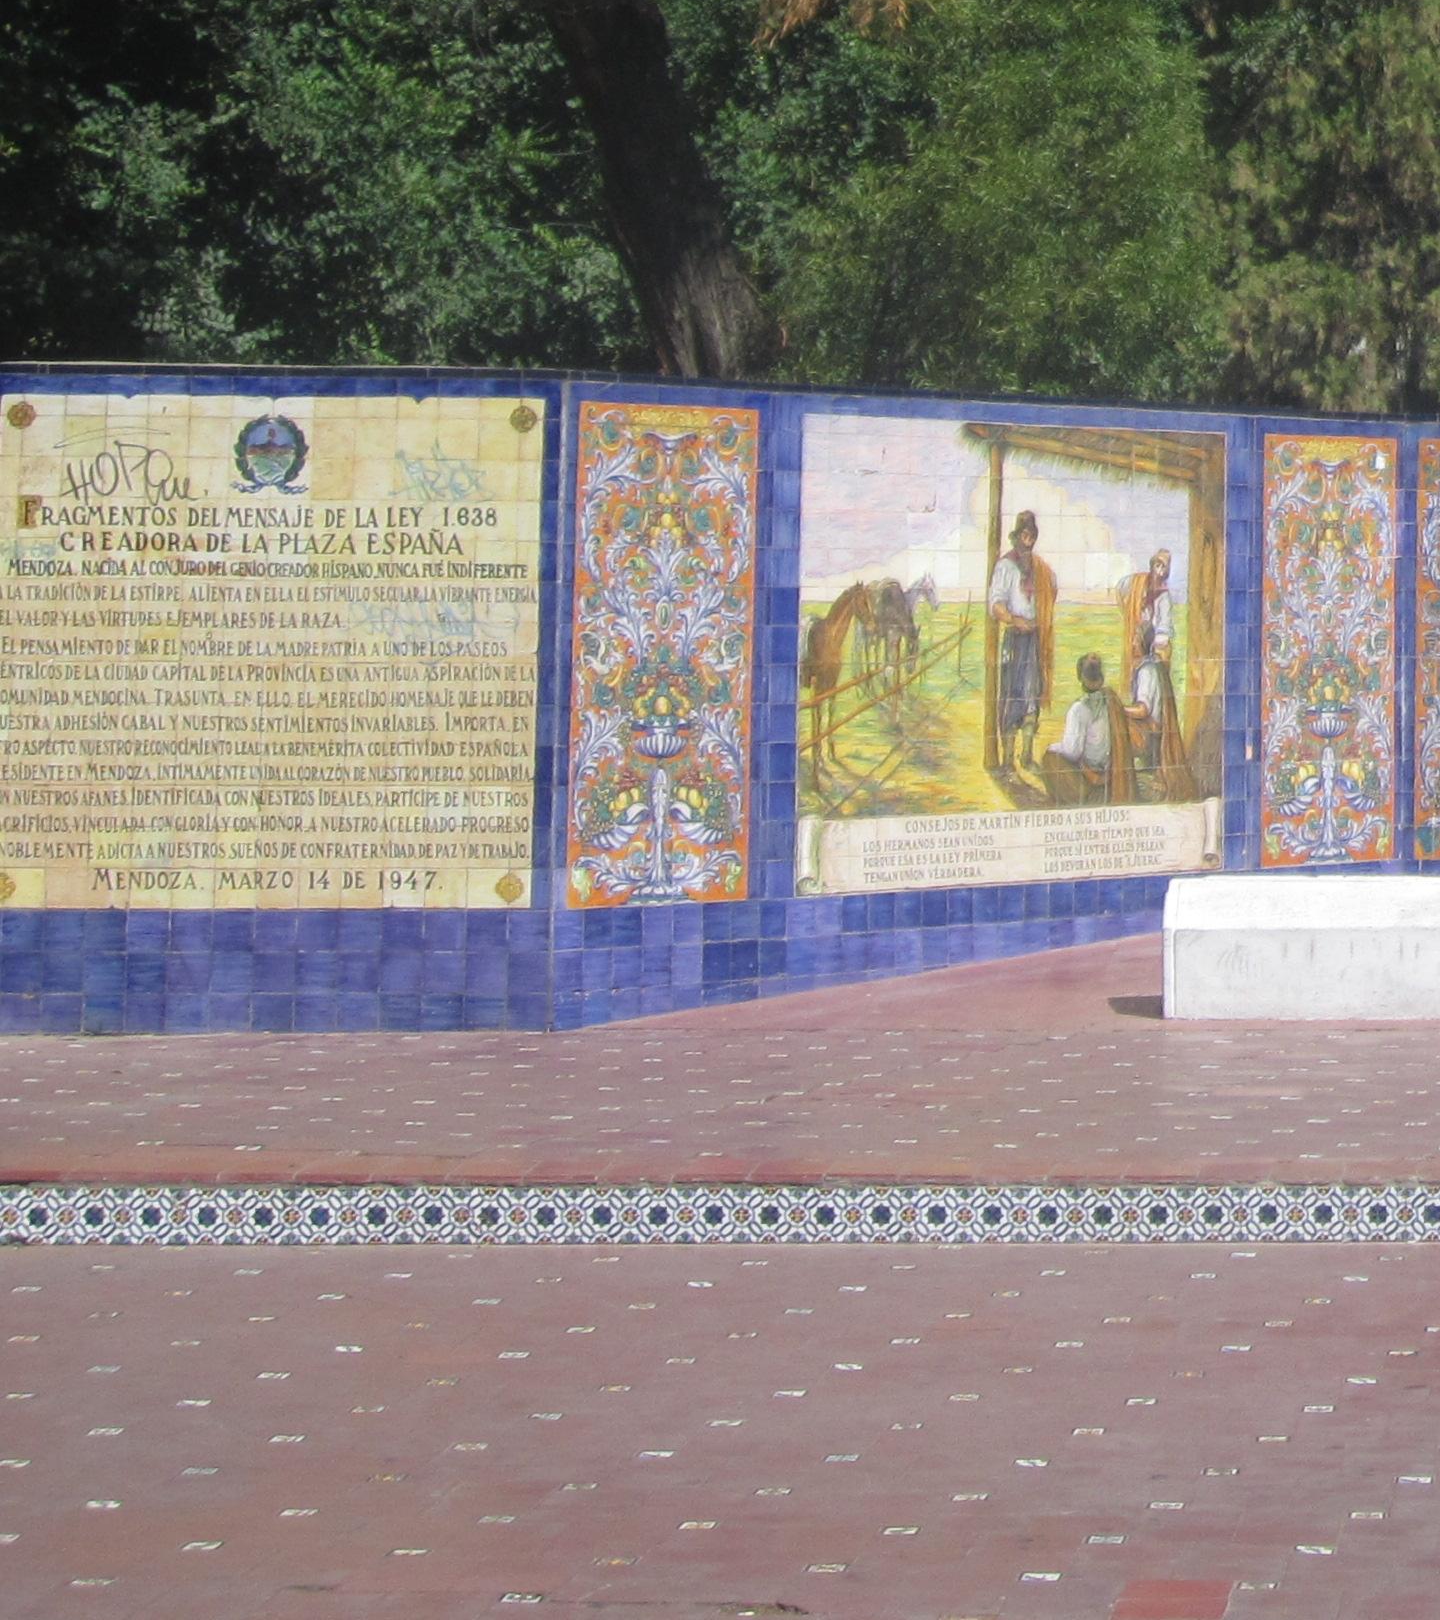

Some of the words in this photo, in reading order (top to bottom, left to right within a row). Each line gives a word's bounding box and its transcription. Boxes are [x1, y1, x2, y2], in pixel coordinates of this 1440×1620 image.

[23, 501, 177, 527] FRAGMENTOS
[188, 507, 221, 527] DEL
[225, 505, 313, 527] MENSAJE
[325, 508, 346, 528] DE
[355, 508, 377, 528] LA
[386, 507, 423, 528] LEY
[443, 507, 498, 528] 1.638
[60, 532, 198, 552] CREADORA
[206, 532, 231, 553] DE
[242, 532, 268, 554] LA
[279, 533, 356, 555] PLAZA
[367, 529, 464, 556] ESPAÑA
[82, 558, 126, 576] NACIDA
[150, 560, 206, 576] CONJURO
[208, 561, 227, 576] DEL
[231, 561, 265, 577] GENIO
[267, 562, 319, 578] CREADOR
[376, 562, 418, 578] NUNCA
[422, 560, 444, 578] FUÉ
[447, 561, 529, 579] INDIFERENTE
[7, 585, 21, 601] LA
[95, 586, 108, 601] DE
[112, 586, 126, 601] LA
[190, 583, 241, 602] ALIENTA
[245, 587, 262, 602] EN
[265, 587, 293, 602] ELLA
[297, 587, 310, 602] EL
[424, 587, 437, 602] LA
[16, 610, 57, 626] VALOR
[73, 610, 96, 627] LAS
[100, 609, 161, 627] VIRTUDES
[166, 610, 256, 629] EJEMPLARES
[259, 612, 276, 629] DE
[279, 612, 297, 629] LA
[2, 636, 16, 654] EL
[20, 636, 113, 655] PENSAMIENTO
[116, 639, 130, 655] DE
[135, 639, 160, 655] DAR
[163, 639, 177, 656] EL
[238, 641, 253, 656] DE
[257, 641, 271, 656] LA
[276, 641, 319, 657] MADRE
[321, 638, 366, 657] PATRIA
[372, 642, 380, 656] A
[383, 642, 407, 656] UNO
[412, 642, 426, 657] DE
[430, 641, 450, 657] LOS
[457, 641, 507, 657] PASEOS
[66, 665, 80, 680] DE
[85, 665, 99, 680] LA
[104, 663, 148, 680] CIUDAD
[152, 662, 206, 681] CAPITAL
[211, 666, 225, 681] DE
[228, 666, 243, 681] LA
[247, 663, 315, 681] PROVINCIA
[320, 666, 334, 681] ES
[336, 666, 358, 681] UNA
[364, 665, 418, 681] ANTIGUA
[423, 663, 499, 681] ASPIRACIÓN
[504, 666, 516, 681] DE
[520, 666, 535, 682] LA
[154, 688, 225, 706] TRASUNTA
[234, 691, 251, 707] EN
[297, 691, 314, 708] EL
[319, 689, 386, 708] MERECIDO
[391, 688, 454, 707] HOMENAJE
[458, 691, 477, 708] QUE
[480, 691, 492, 707] LE
[497, 690, 533, 707] DEBEN
[54, 711, 118, 730] ADHESIÓN
[121, 715, 165, 730] CABAL
[183, 716, 248, 732] NUESTROS
[252, 715, 348, 733] SENTIMIENTOS
[512, 716, 528, 732] EN
[79, 741, 133, 756] NUESTRO
[134, 738, 232, 756] RECONOCIMIENTO
[368, 739, 454, 757] COLECTIVIDAD
[460, 739, 528, 757] ESPAÑOLA
[68, 765, 82, 780] EN
[158, 763, 246, 781] INTIMAMENTE
[297, 763, 350, 781] CORAZÓN
[353, 766, 366, 781] DE
[369, 766, 418, 781] NUESTRO
[14, 789, 78, 806] NUESTROS
[131, 787, 221, 807] IDENTIFICADA
[225, 790, 248, 806] CON
[251, 789, 315, 807] NUESTROS
[444, 791, 458, 807] DE
[463, 791, 529, 807] NUESTROS
[73, 814, 145, 833] VINCULADA
[151, 816, 174, 832] CON
[175, 814, 218, 832] GLORIA
[233, 816, 257, 832] CON
[321, 816, 378, 832] NUESTRO
[382, 816, 456, 833] ACELERADO
[462, 816, 529, 834] PROGRESO
[905, 817, 960, 834] CONSEJOS
[962, 818, 975, 830] DE
[1024, 813, 1064, 828] FIERRO
[1075, 812, 1092, 825] SUS
[97, 840, 143, 860] ADICTA
[158, 842, 226, 859] NUESTROS
[228, 839, 279, 860] SUEÑOS
[281, 843, 297, 859] DE
[419, 843, 433, 859] DE
[436, 843, 458, 859] PAZ
[218, 870, 293, 891] MARZO
[308, 869, 331, 890] 14
[343, 870, 364, 890] DE
[379, 870, 443, 891] 1947.
